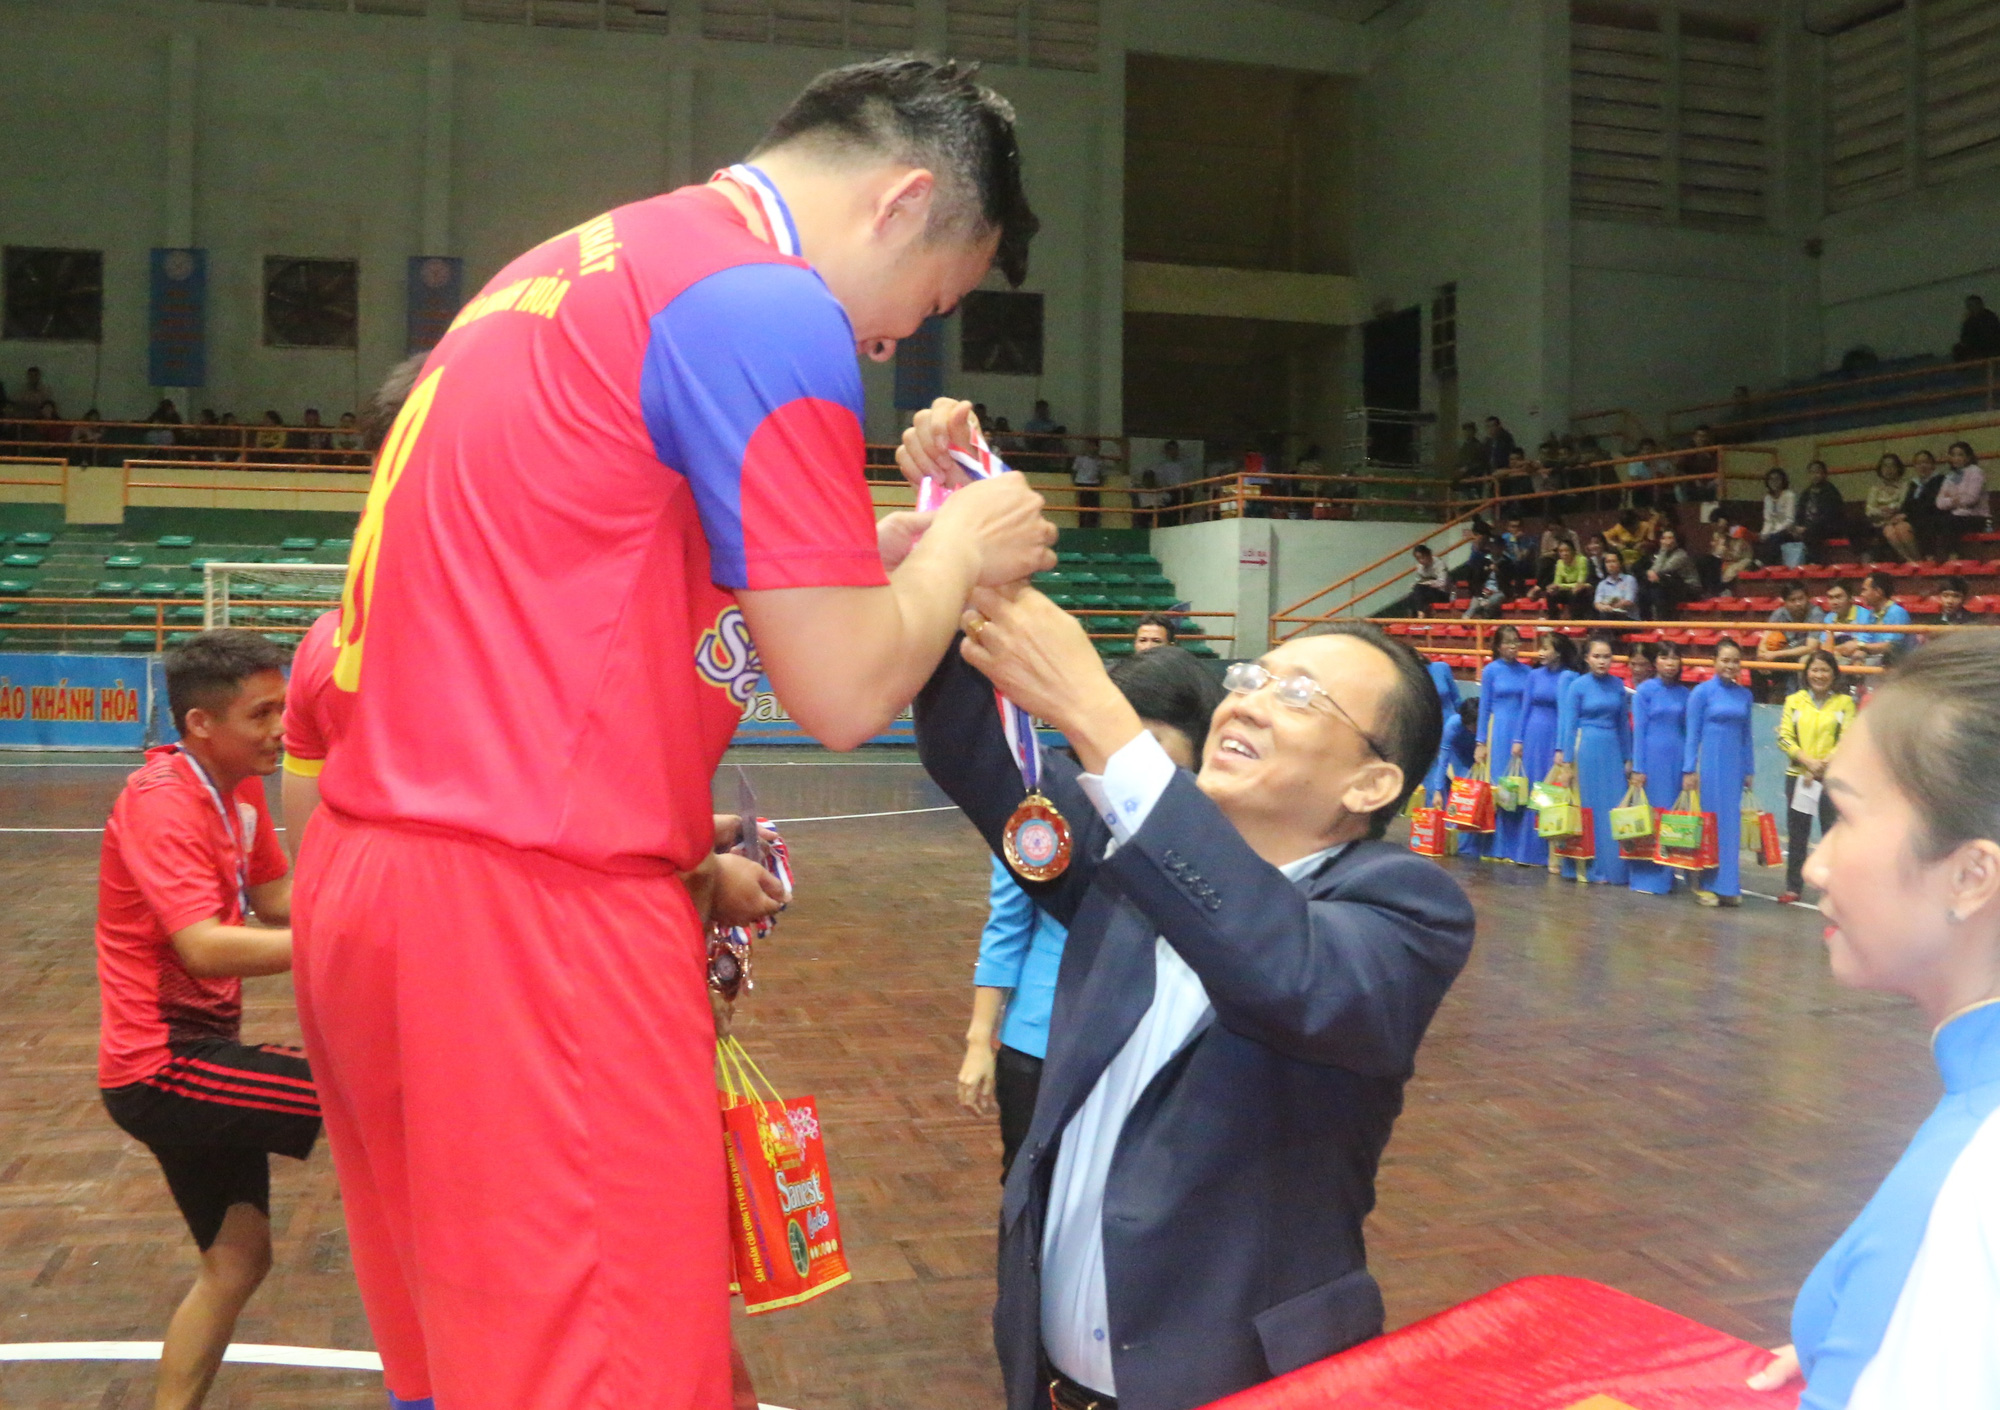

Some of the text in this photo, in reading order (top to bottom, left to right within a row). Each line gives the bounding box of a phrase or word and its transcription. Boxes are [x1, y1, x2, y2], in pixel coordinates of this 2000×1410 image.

[31, 678, 95, 721] KHÁNH
[101, 679, 139, 722] HÒA
[739, 1202, 748, 1211] TY
[774, 1170, 824, 1214] Sanest
[741, 1211, 753, 1231] CÔNG
